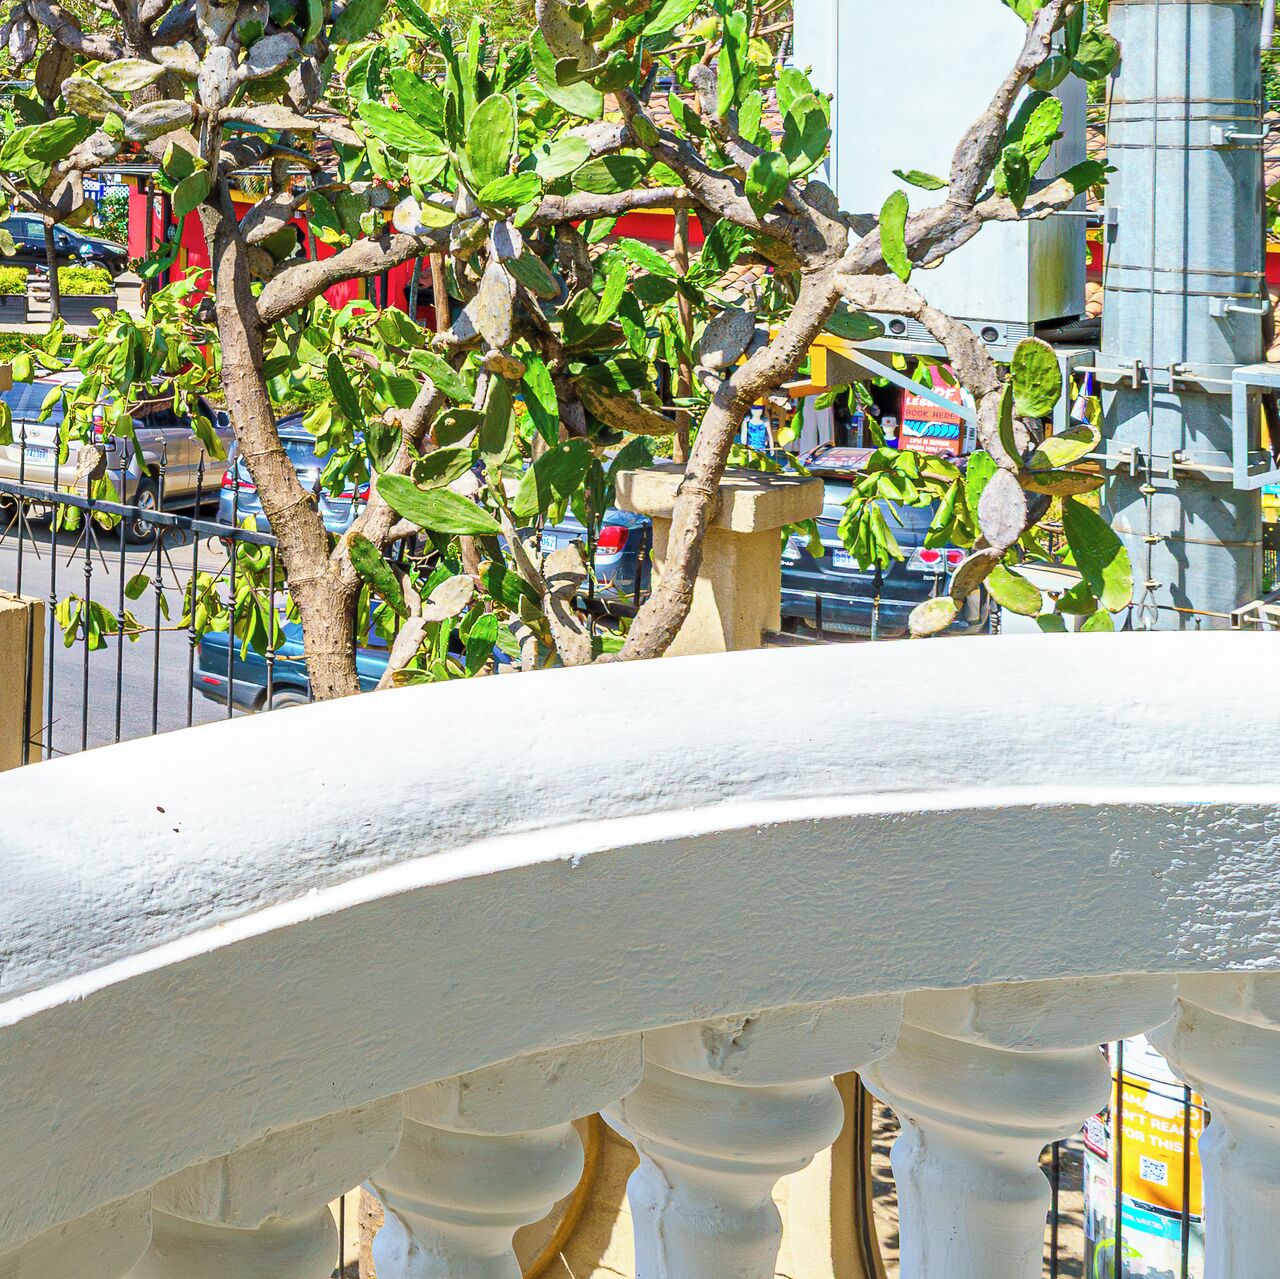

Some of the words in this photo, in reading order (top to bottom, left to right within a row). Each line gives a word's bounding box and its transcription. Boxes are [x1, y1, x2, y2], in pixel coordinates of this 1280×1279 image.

[905, 408, 929, 418] BOOK
[932, 410, 956, 420] HERE
[1150, 1118, 1201, 1139] REAY
